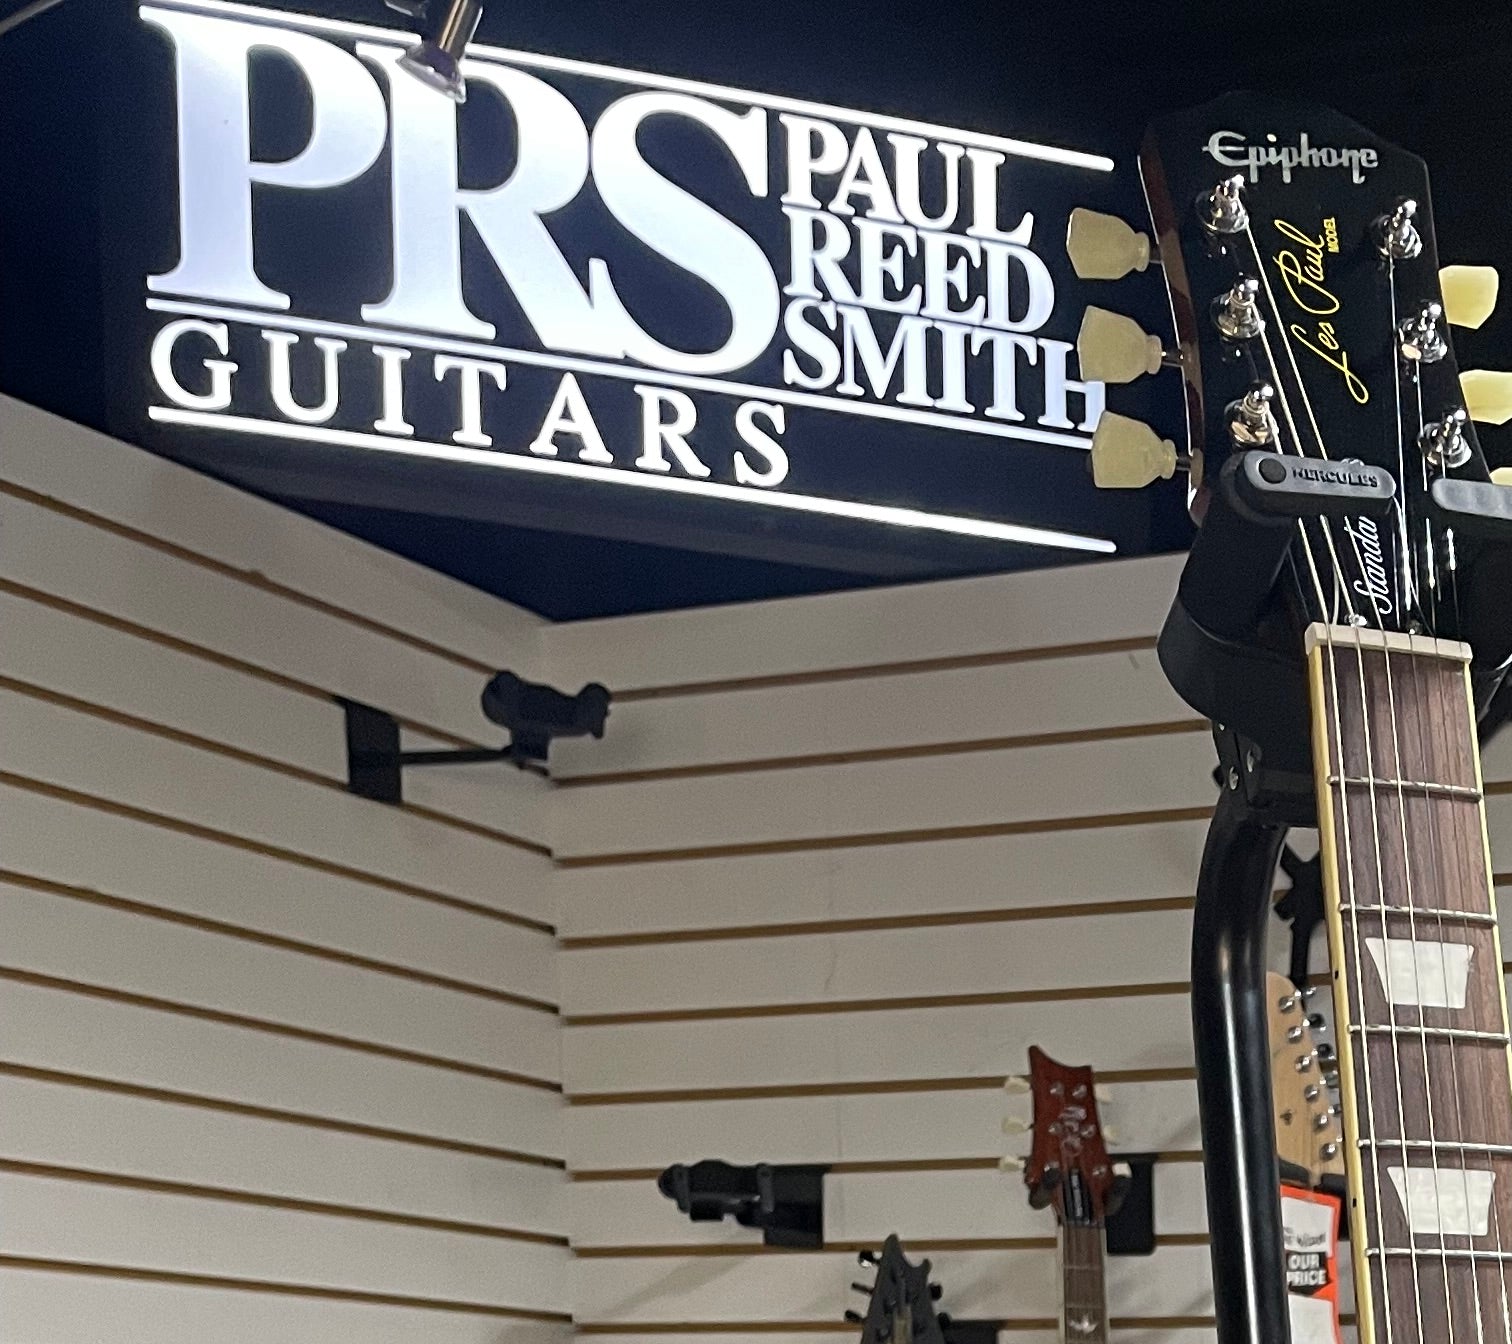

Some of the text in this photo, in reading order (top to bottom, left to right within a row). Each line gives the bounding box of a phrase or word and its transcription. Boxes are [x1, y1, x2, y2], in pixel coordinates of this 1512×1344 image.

[139, 6, 782, 375] PRS
[779, 113, 1034, 248] PAUL
[1202, 130, 1379, 184] Epiphone
[781, 205, 1055, 330] REED
[1323, 217, 1340, 253] MODEL
[782, 299, 1105, 433] SMITH
[1273, 219, 1369, 404] Les Paul
[149, 318, 790, 488] GUITARS
[1291, 466, 1379, 489] HERCULES
[1343, 515, 1393, 616] Standa
[1286, 1269, 1327, 1286] PRICE
[1288, 1253, 1320, 1270] OUR
